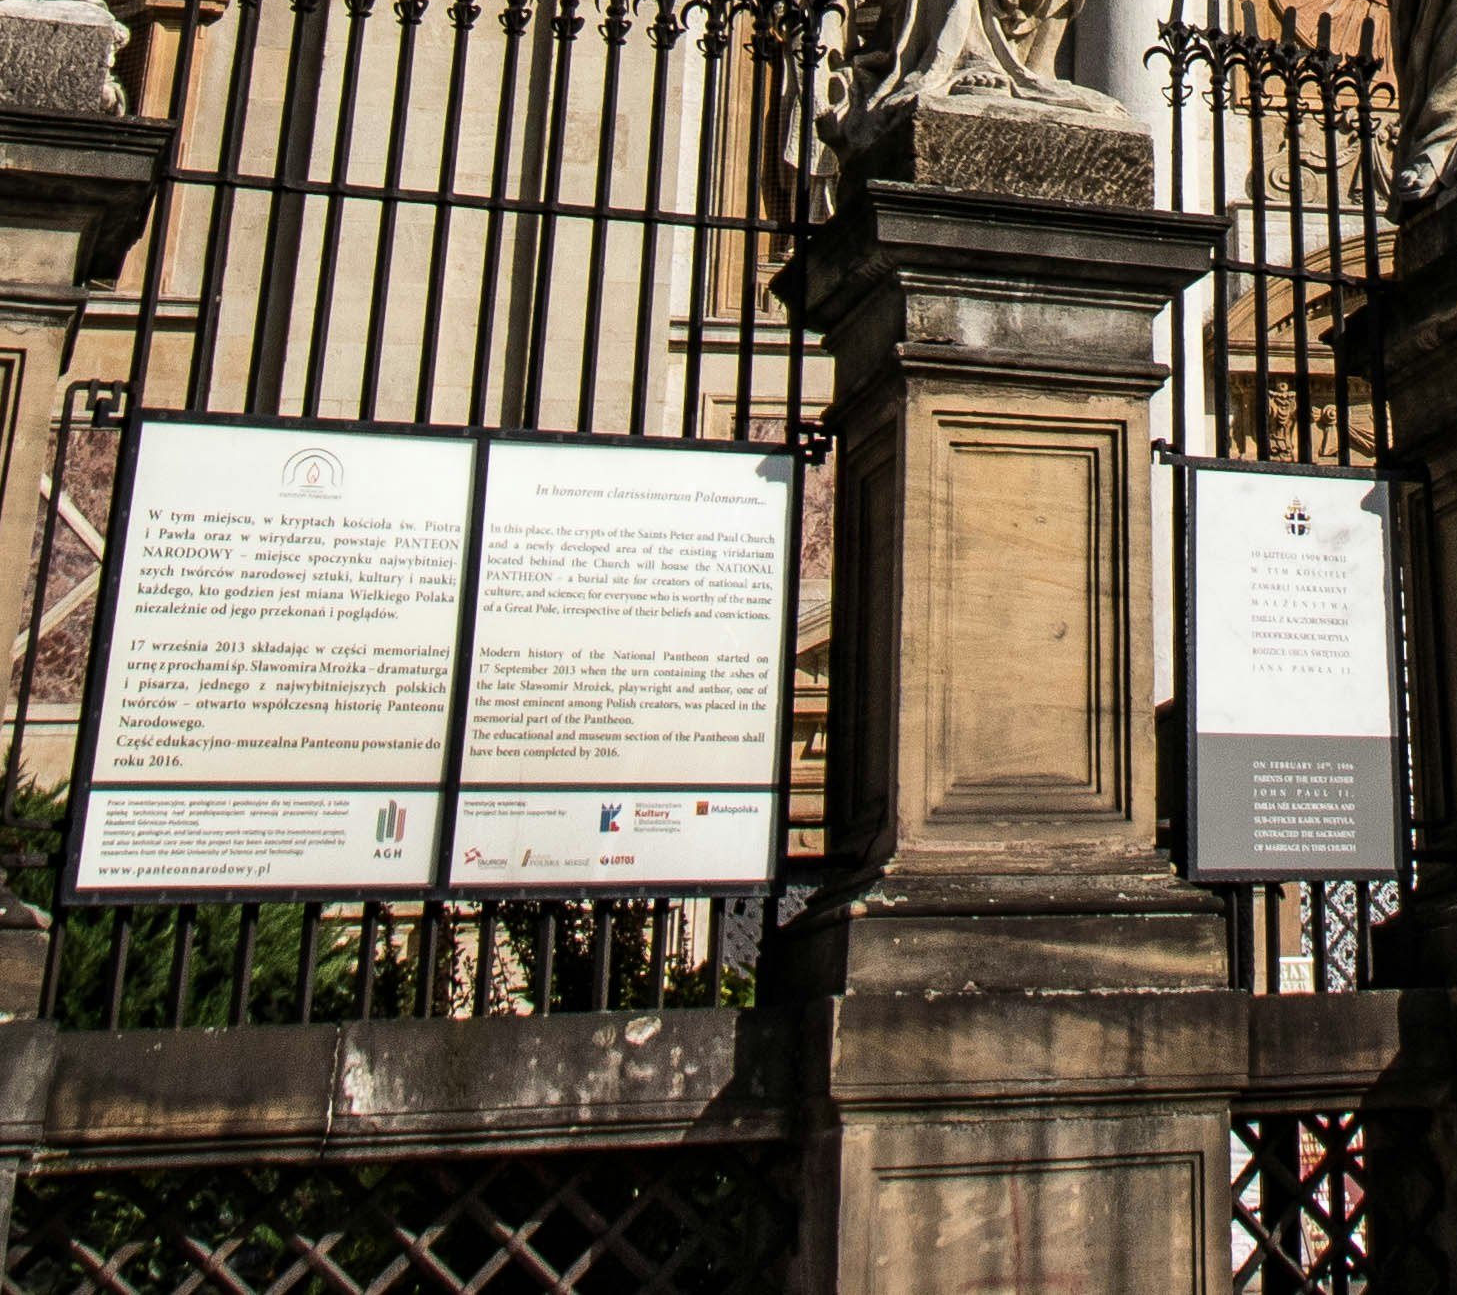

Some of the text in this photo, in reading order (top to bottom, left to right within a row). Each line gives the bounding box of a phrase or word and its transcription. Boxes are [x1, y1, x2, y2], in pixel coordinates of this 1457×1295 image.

[536, 484, 549, 495] In
[552, 486, 604, 498] honorem
[607, 487, 692, 502] clarissimorum
[170, 511, 460, 532] tym miejscu, kryptach kościoła św. Piotra
[158, 527, 458, 550] Pawła oraz wirydarzu, powstaje PANTEON
[142, 546, 456, 570] NARODOWY miejsce spoczynku najwybitniej-
[139, 564, 456, 587] szych twórców narodowej sztuki, kultury nauki;
[486, 570, 552, 582] PANTHEON
[716, 562, 774, 574] NATIONAL
[137, 582, 454, 605] każdego, kto godzien jest miana Wielkiego Polaka
[134, 601, 398, 622] niezależnie od jego przekonań poglądów.
[130, 639, 450, 660] 17 września 2013 składając części memorialnej
[479, 646, 768, 664] Modern history of the National Pantheon started on
[127, 658, 448, 679] urnę prochami śp. Sławomira Mrożka dramaturga
[493, 662, 548, 677] September
[552, 664, 576, 675] 2013
[580, 664, 607, 676] when
[611, 664, 627, 676] the
[631, 668, 649, 677] urn
[653, 667, 706, 681] containing
[710, 667, 726, 678] the
[758, 668, 770, 680] of
[138, 677, 446, 696] pisarza, jednego najwybitniejszych polskich
[121, 696, 444, 714] twórców otwarto współczesną historię Panteonu
[118, 714, 205, 732] Narodowego.
[472, 712, 634, 727] memorial part of the Pantheon.
[116, 734, 441, 752] Część edukacyjno-muzealna Panteonu powstanie do
[113, 753, 183, 767] roku 2016.
[469, 745, 620, 760] have been completed by 2016.
[1270, 761, 1312, 769] FEBRUARY
[1253, 789, 1287, 797] JOHN
[1297, 789, 1328, 797] PAUL
[635, 809, 670, 820] Kultury
[711, 804, 759, 815] Małopolska
[374, 848, 402, 859] AGH
[611, 855, 635, 865] LOTOS
[99, 864, 271, 877] www.panteonnarodowy.pl
[1280, 964, 1310, 979] GAN
